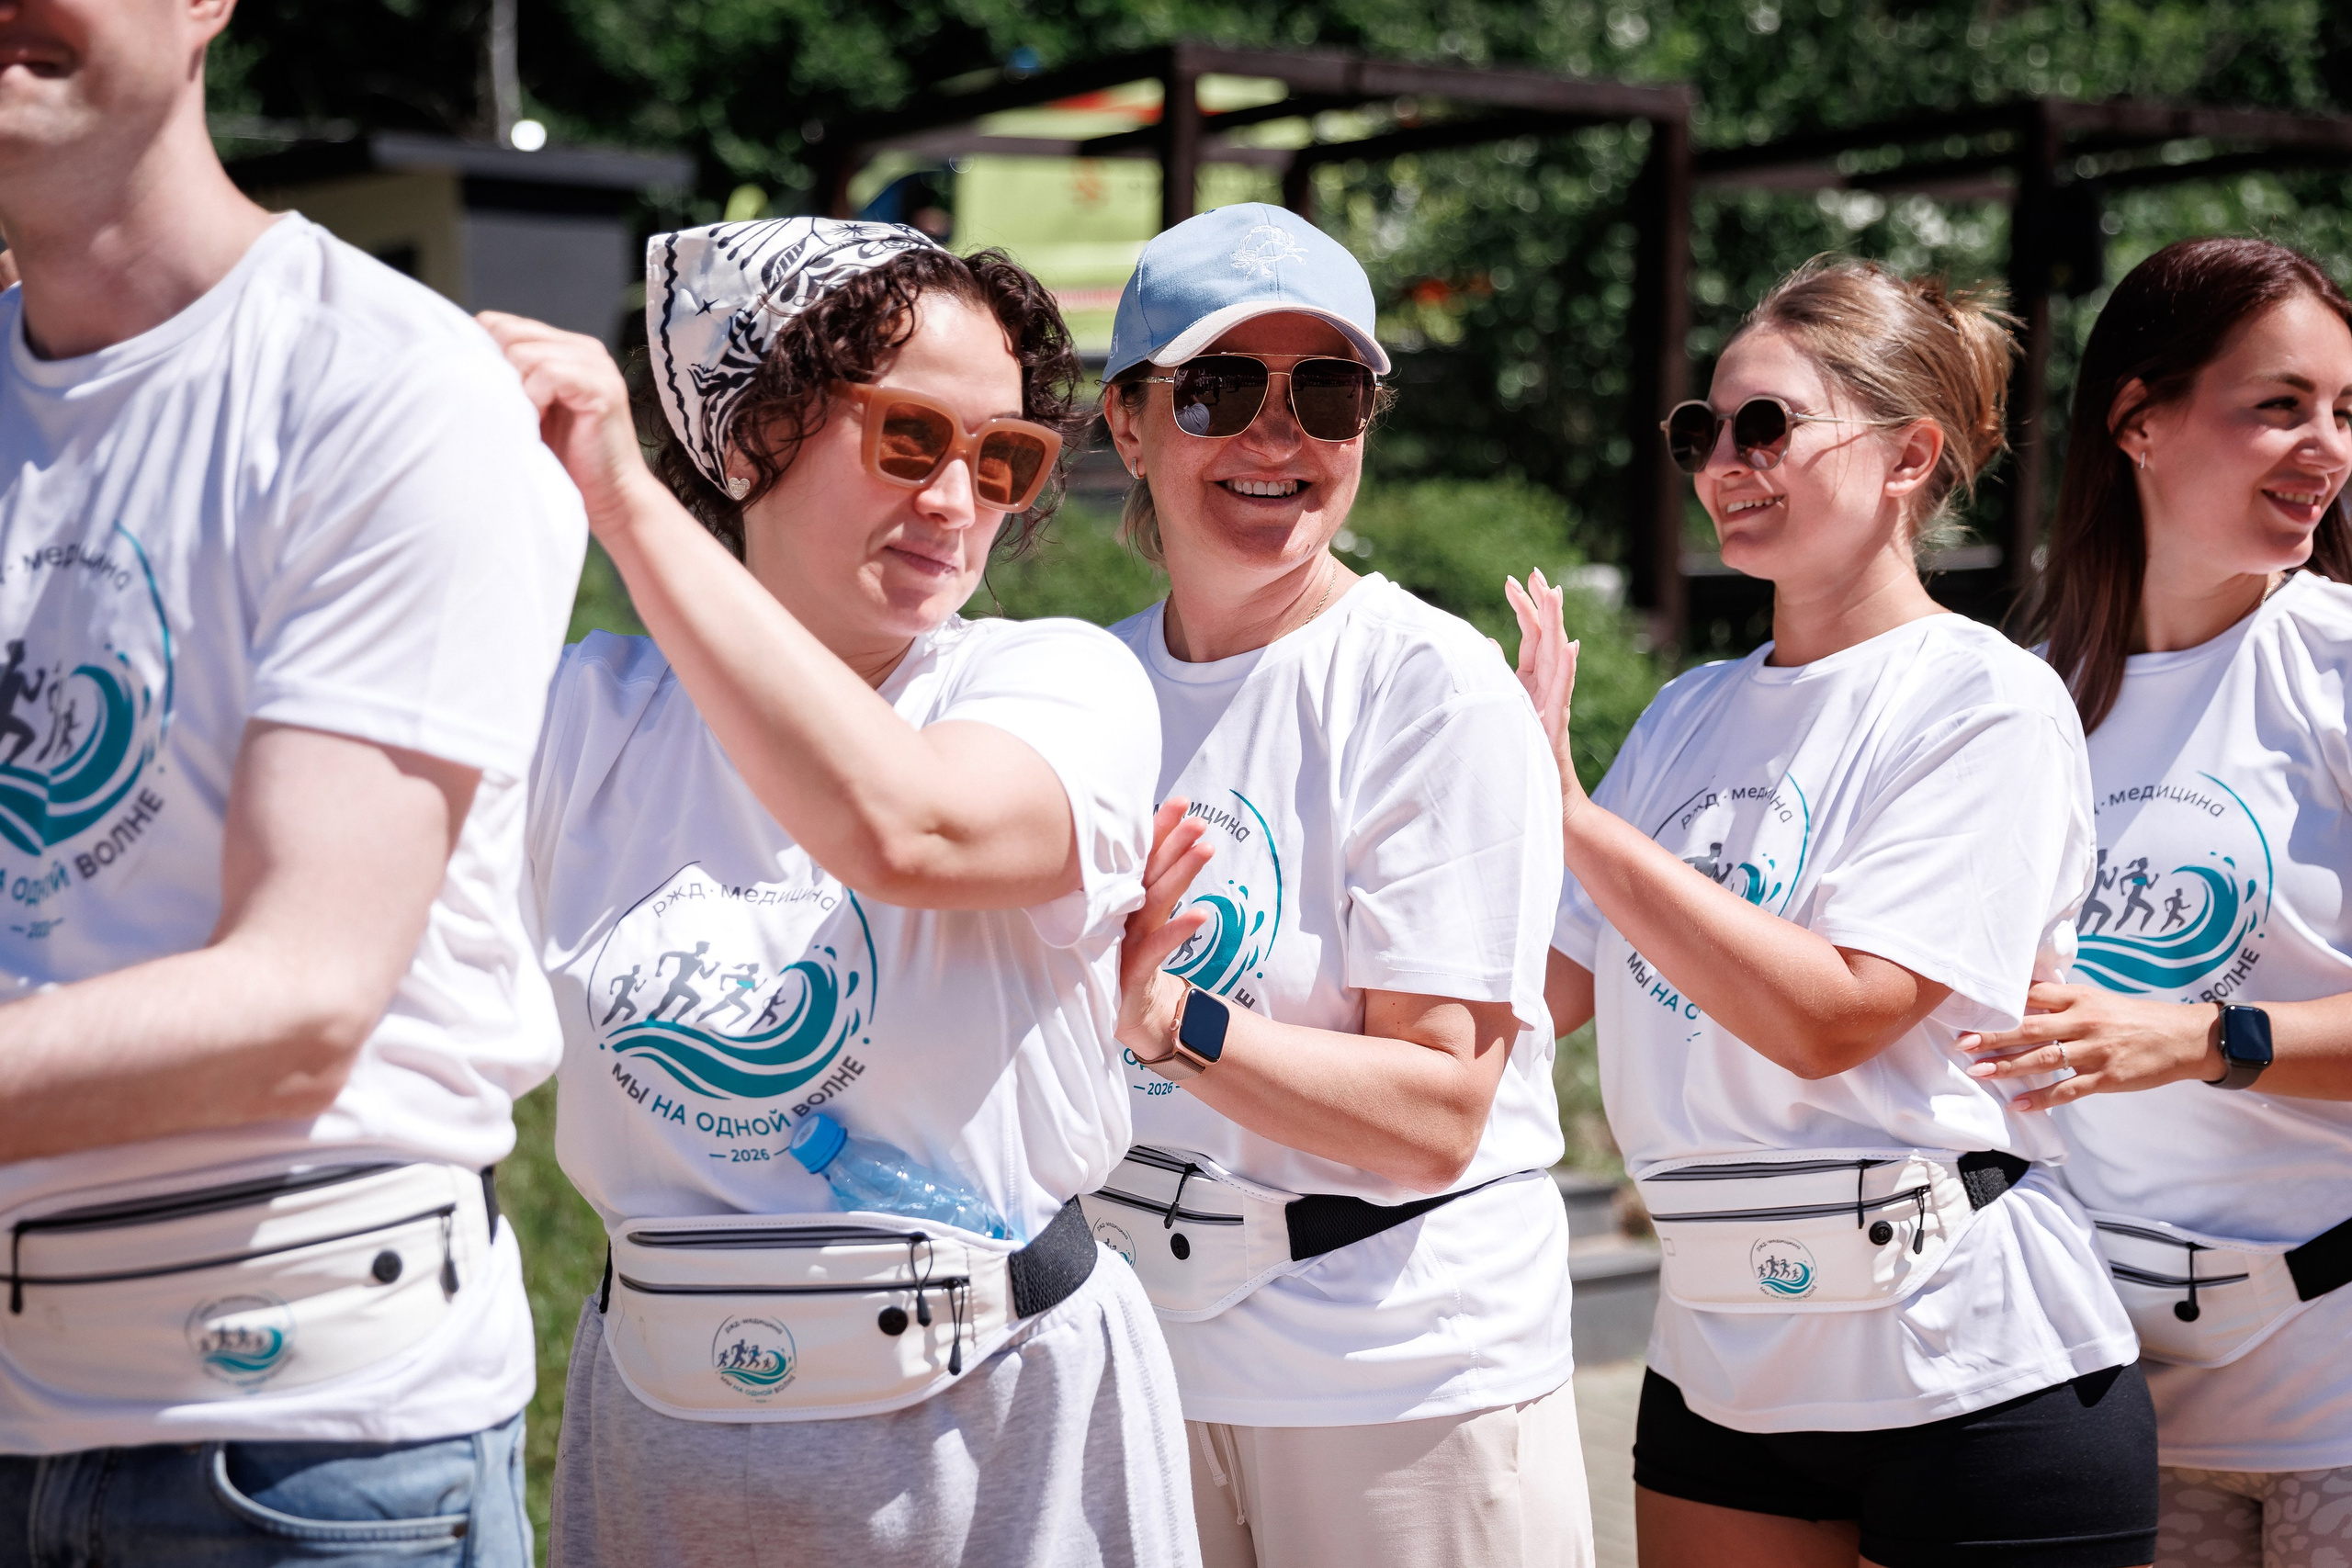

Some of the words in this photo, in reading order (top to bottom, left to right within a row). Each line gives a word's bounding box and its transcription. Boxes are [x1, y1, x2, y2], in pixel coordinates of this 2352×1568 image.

[1153, 801, 1250, 843] ицина
[2109, 784, 2225, 818] медицина
[74, 785, 164, 880] ВОЛНЕ
[1626, 951, 1653, 988] МЫ
[1650, 982, 1679, 1012] НА
[2199, 947, 2260, 1003] ВОЛНЕ
[611, 1062, 650, 1104] МЫ
[651, 1094, 685, 1125] НА
[695, 1108, 792, 1139] ОДНОЙ
[791, 1055, 866, 1118] ВОЛНЕ
[1148, 1082, 1174, 1096] 2026
[730, 1148, 771, 1163] 2026
